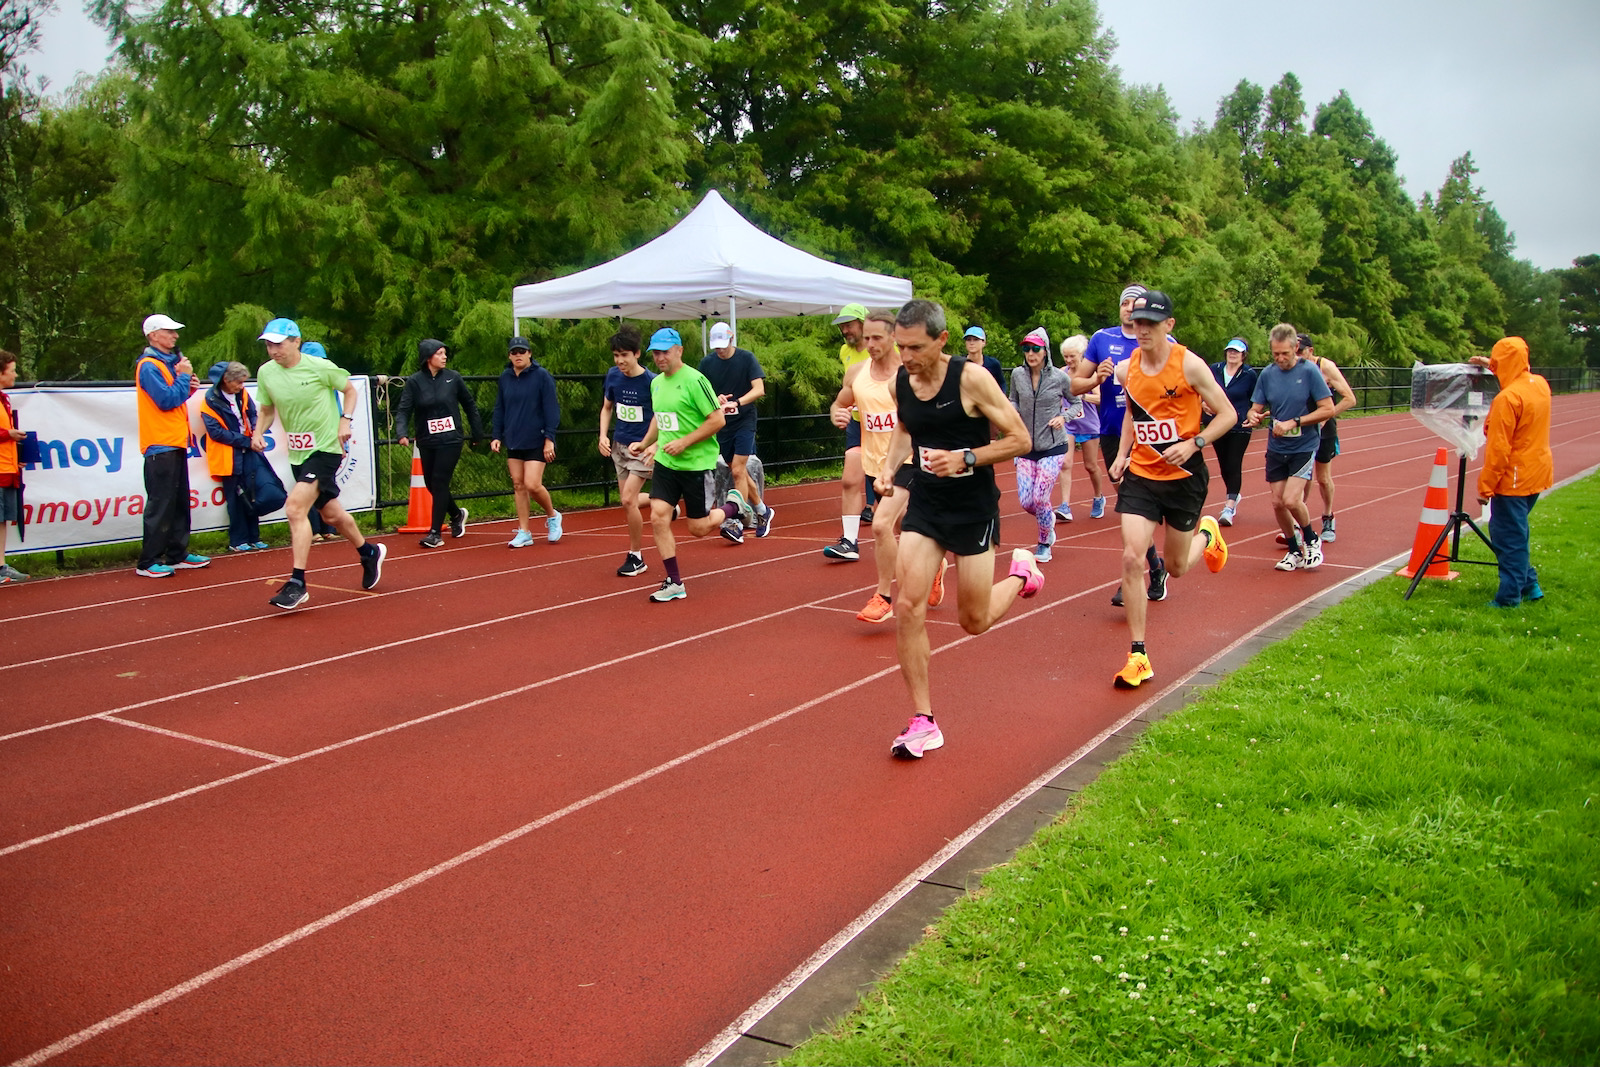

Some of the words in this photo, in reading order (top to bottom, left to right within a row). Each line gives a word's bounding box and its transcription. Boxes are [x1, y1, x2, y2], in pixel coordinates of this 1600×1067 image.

[620, 406, 636, 420] 98
[430, 419, 451, 432] 554
[657, 414, 672, 429] 99
[866, 413, 894, 430] 544
[1137, 422, 1172, 442] 550
[289, 434, 313, 449] 552
[340, 458, 358, 484] TEAM
